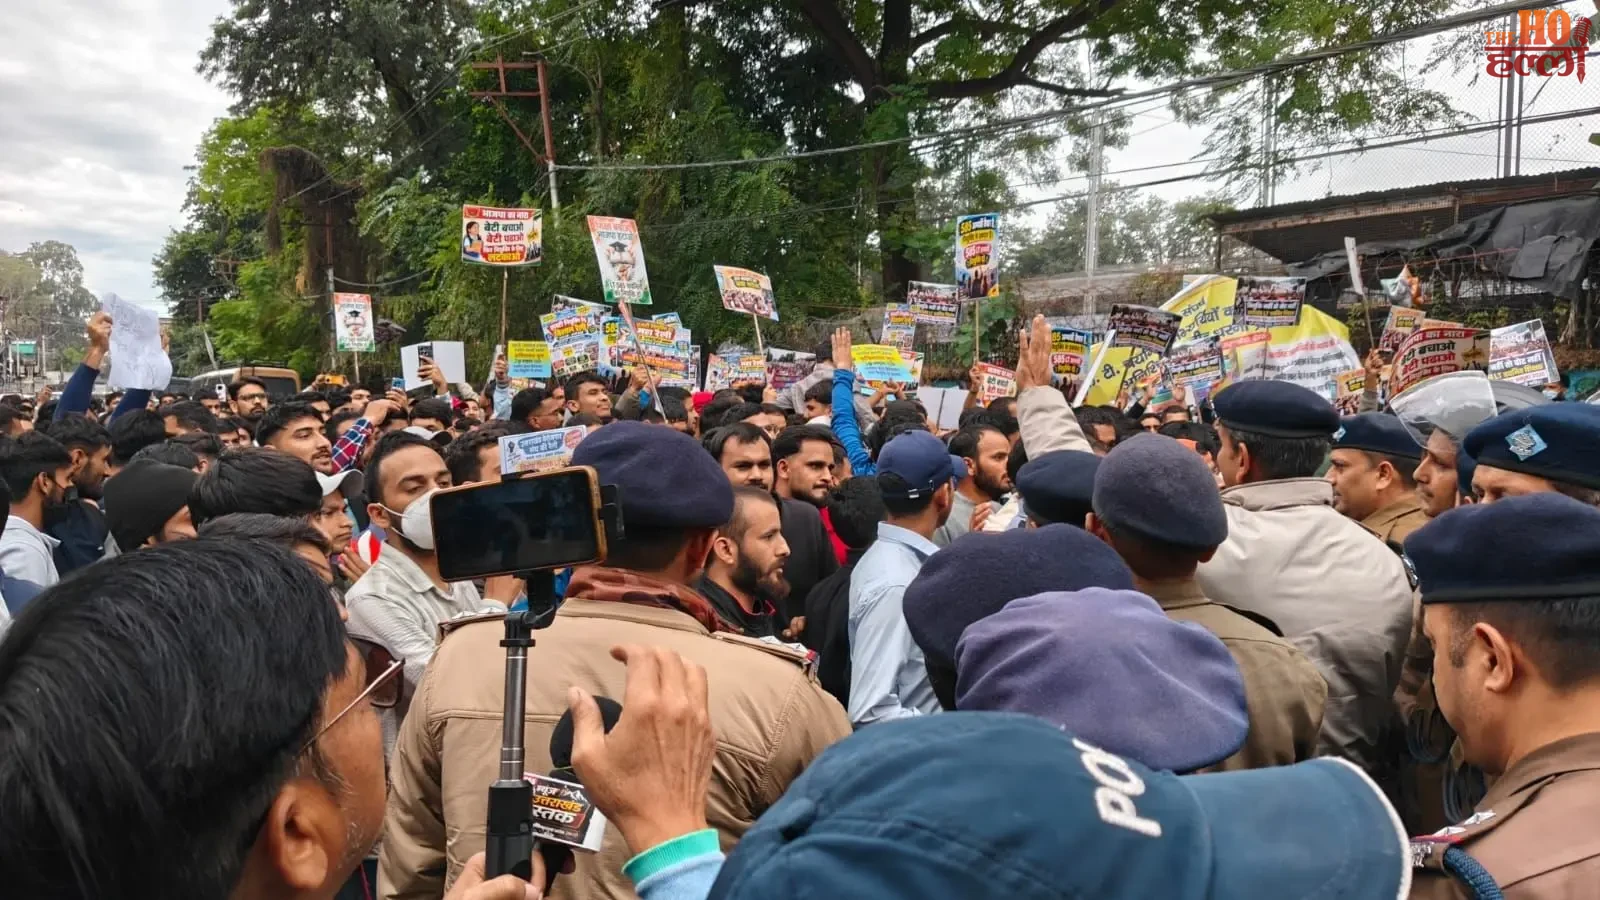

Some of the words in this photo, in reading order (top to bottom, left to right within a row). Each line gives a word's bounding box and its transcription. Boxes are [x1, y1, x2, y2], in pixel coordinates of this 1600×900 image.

[483, 209, 505, 219] भाजपा
[484, 220, 500, 231] बेटी
[502, 222, 524, 231] बचाओ
[486, 231, 502, 242] बेटी
[1425, 330, 1440, 339] का
[1418, 340, 1456, 354] बचाओ
[532, 794, 583, 813] उत्तराखंड
[532, 805, 576, 824] स्तक
